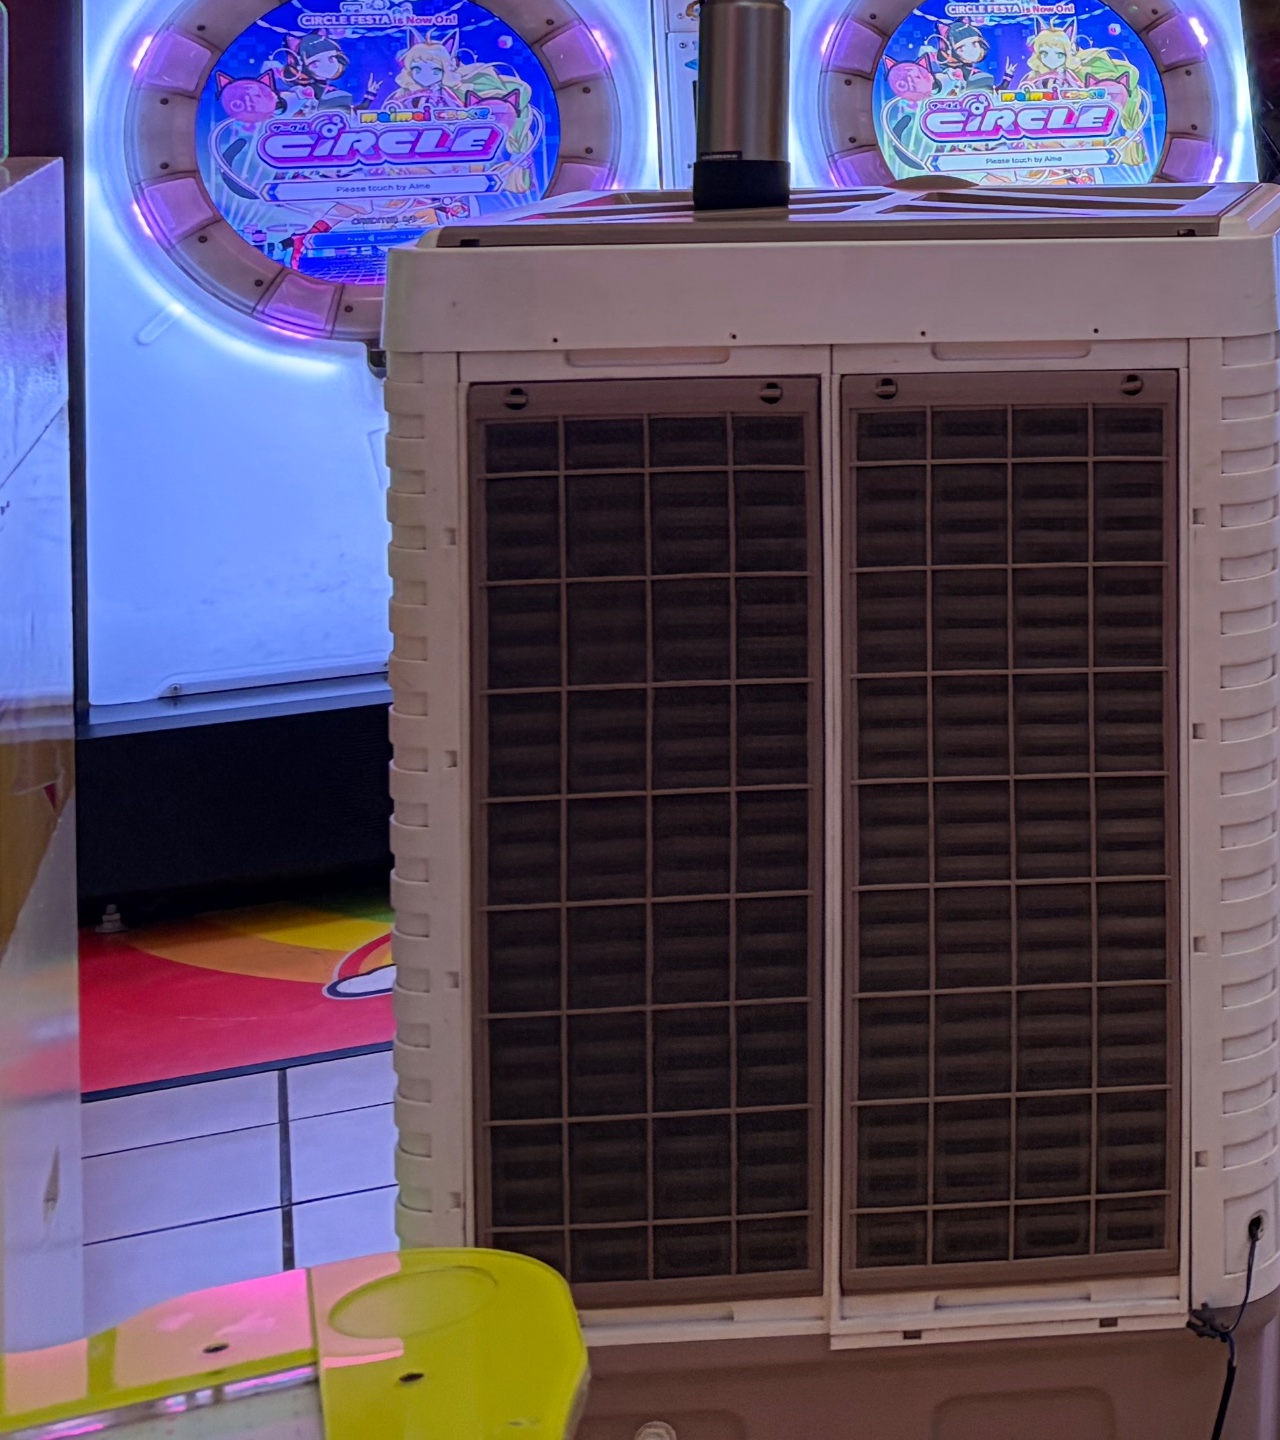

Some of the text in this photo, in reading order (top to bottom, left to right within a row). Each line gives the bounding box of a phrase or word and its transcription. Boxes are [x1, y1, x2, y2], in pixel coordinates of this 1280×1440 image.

[948, 2, 1074, 14] CIRCLE FESTA is Now On!
[302, 13, 457, 26] CIRCLE FESTA is Now On!
[985, 157, 1010, 165] Please
[1011, 156, 1032, 164] touch
[1034, 156, 1043, 164] by
[336, 184, 366, 193] Please
[368, 183, 395, 192] touch
[396, 183, 407, 192] by
